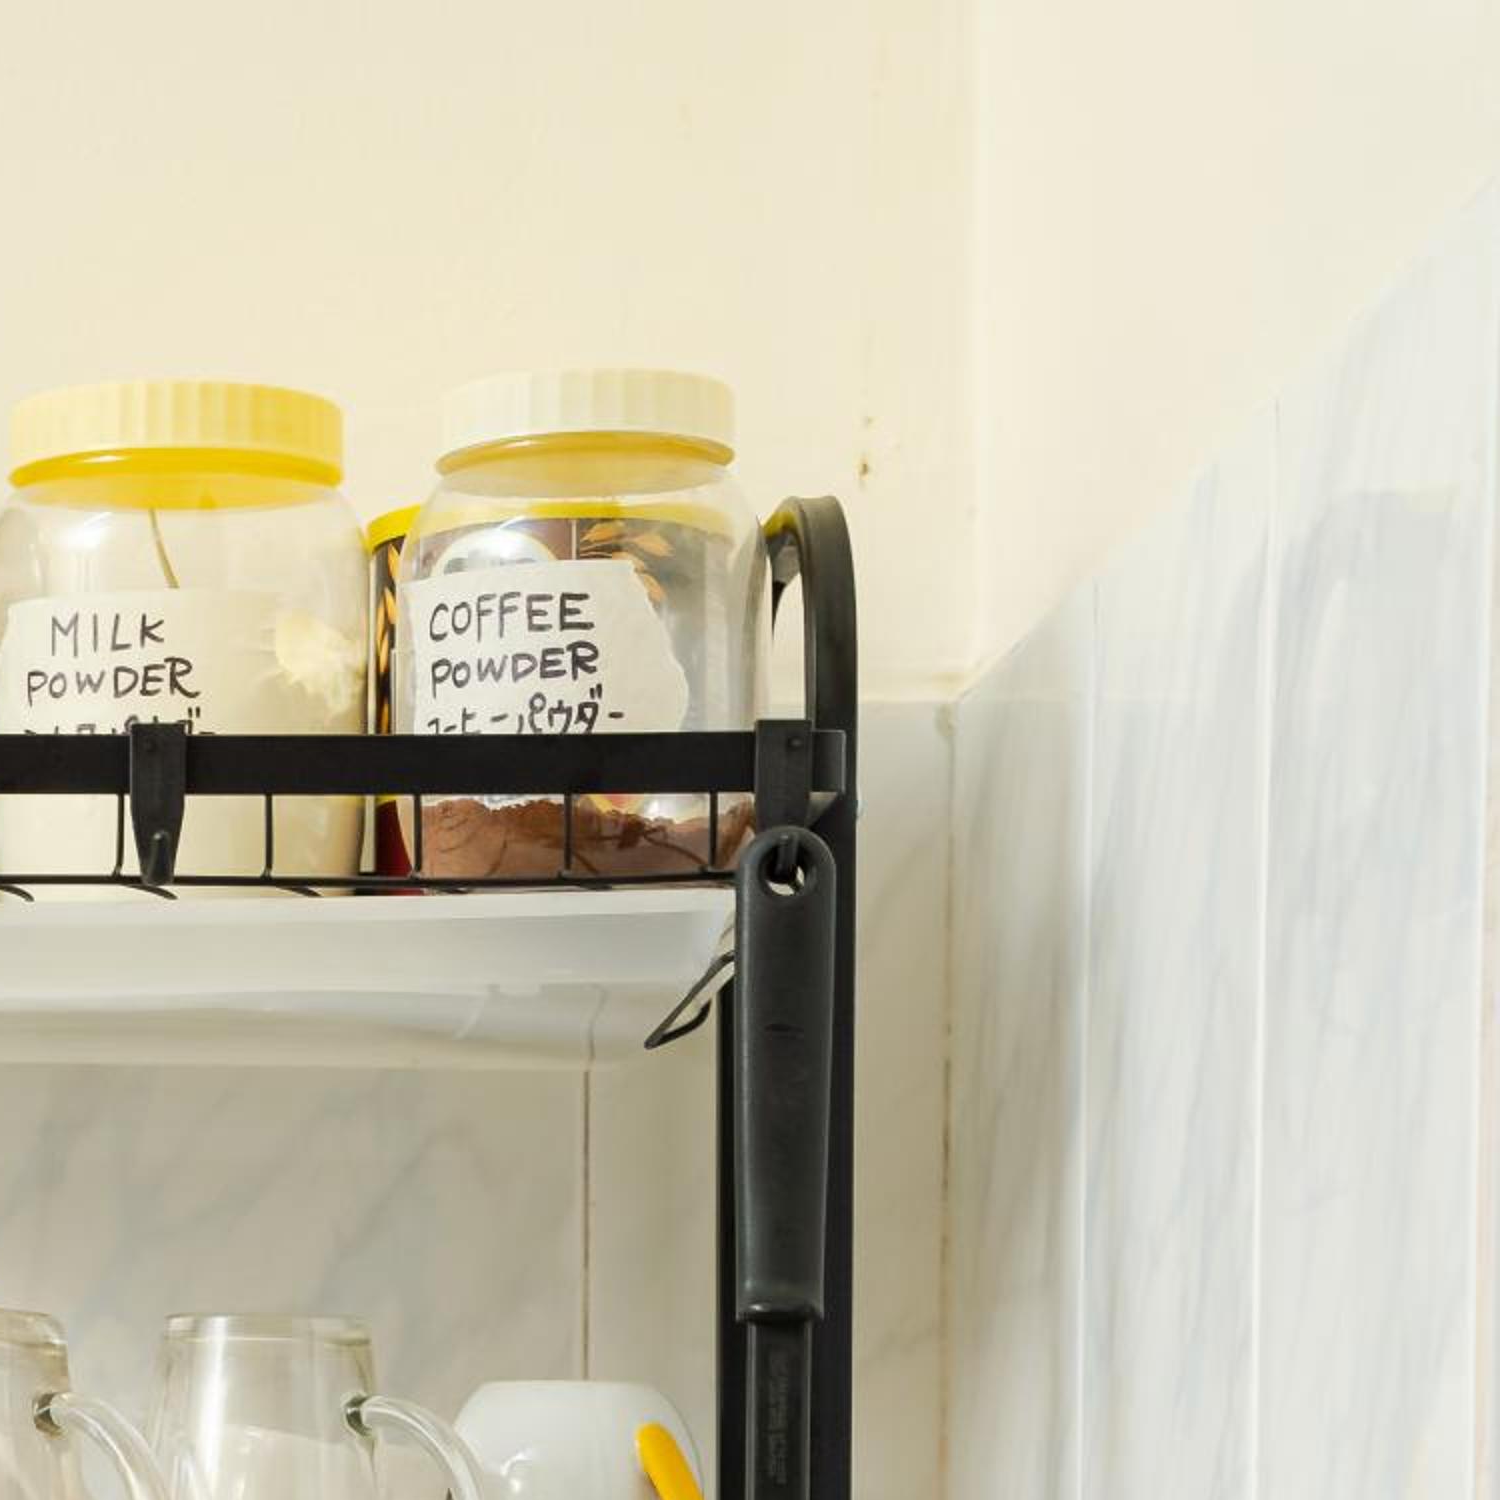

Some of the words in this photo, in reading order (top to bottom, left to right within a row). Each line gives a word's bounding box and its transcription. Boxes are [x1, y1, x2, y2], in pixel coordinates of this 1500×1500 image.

[50, 611, 165, 658] MILK
[428, 591, 595, 642] COFFEE
[26, 656, 202, 708] POWDER
[430, 640, 600, 699] POWDER
